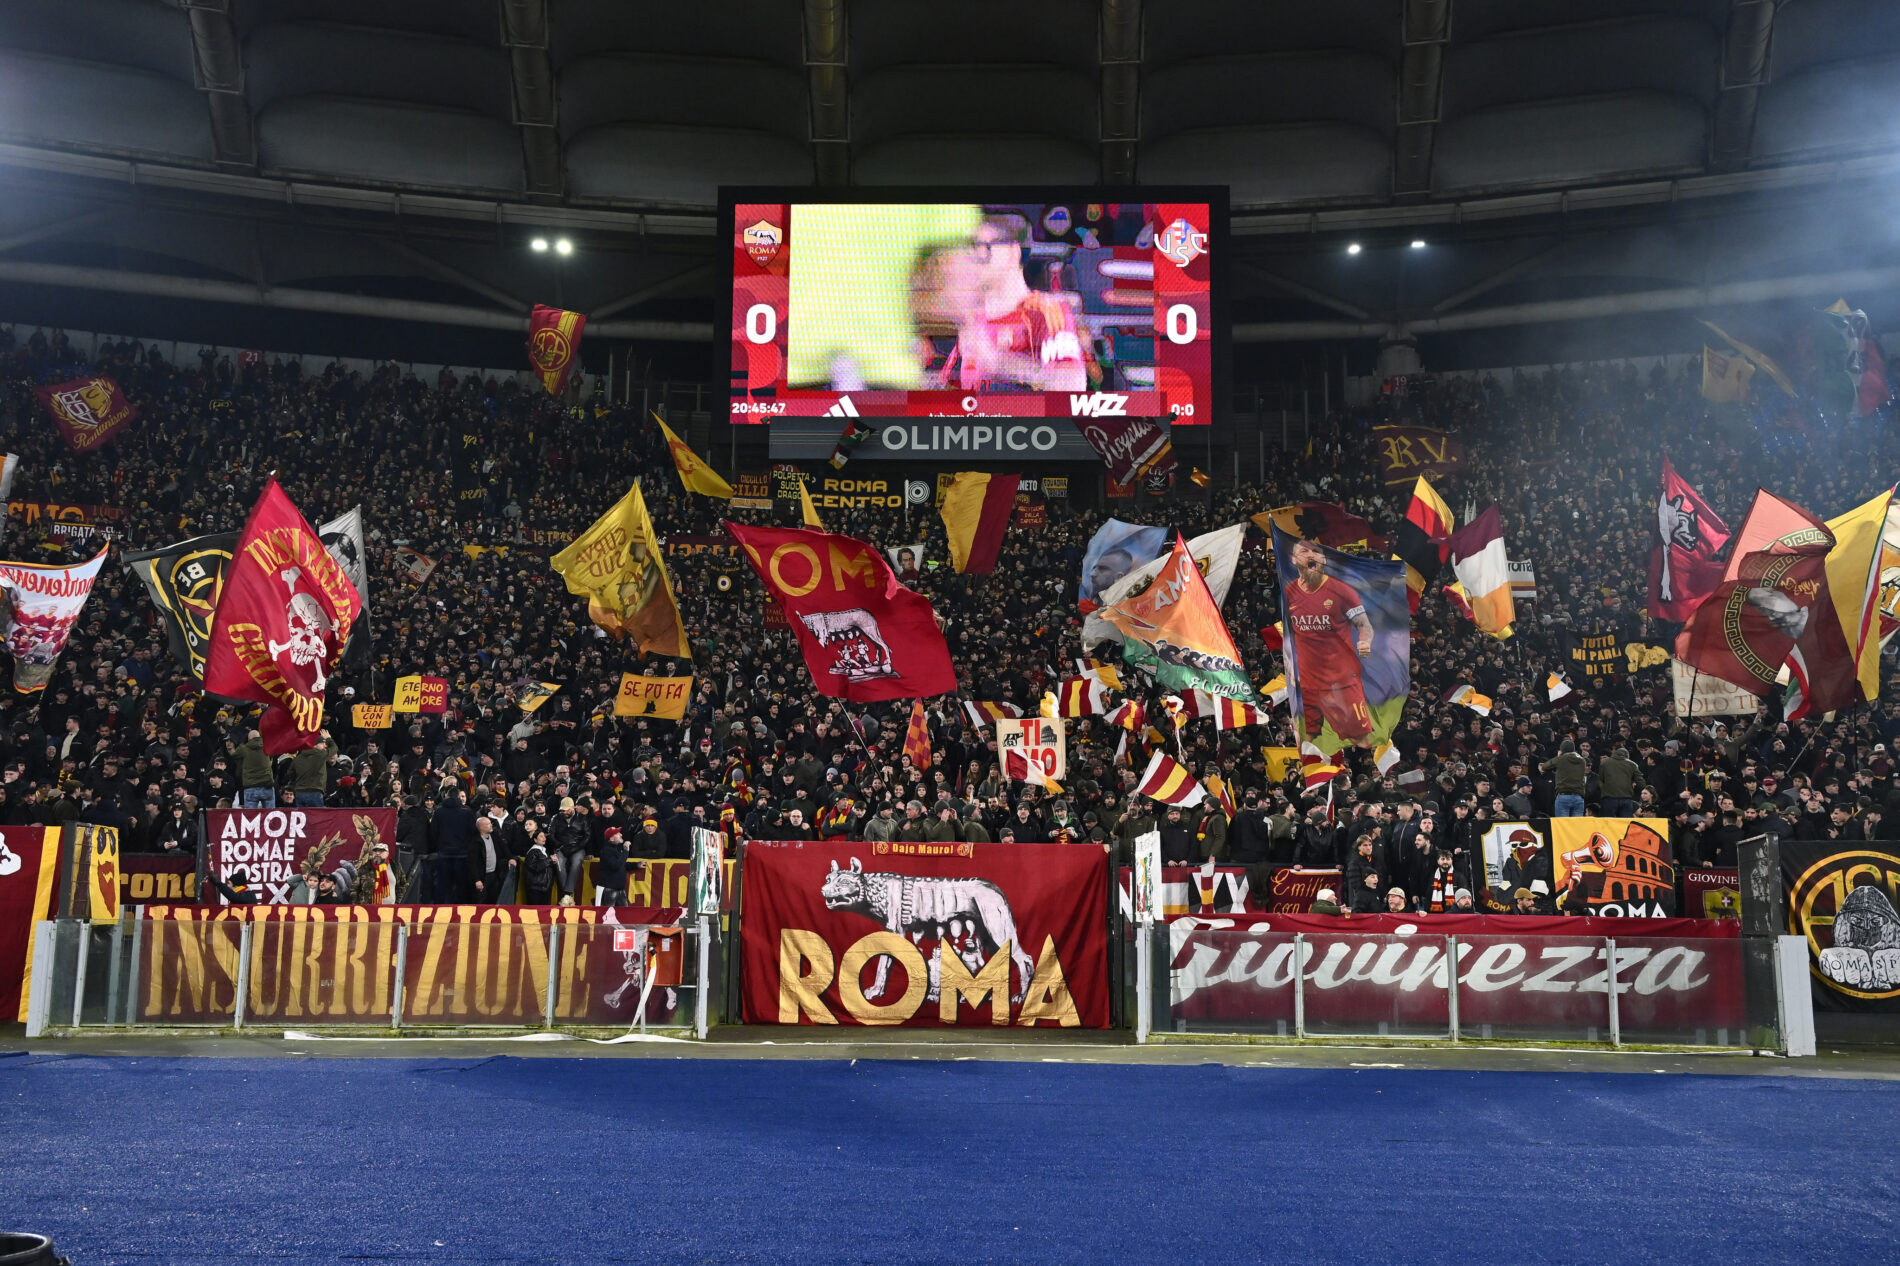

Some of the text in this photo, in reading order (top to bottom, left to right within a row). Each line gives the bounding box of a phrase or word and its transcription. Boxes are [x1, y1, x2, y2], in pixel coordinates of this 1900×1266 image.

[749, 246, 776, 254] ROMA
[746, 304, 776, 345] 0
[1166, 304, 1197, 345] 0
[732, 402, 786, 414] 20:45:47
[1070, 393, 1128, 418] WIZZ
[882, 425, 1057, 451] OLIMPICO
[824, 478, 888, 493] ROMA
[809, 494, 903, 508] CENTRO
[1582, 634, 1615, 648] TUTTO
[1572, 647, 1586, 661] MI
[1586, 663, 1615, 675] DI TE
[402, 682, 444, 692] ETERNO
[624, 681, 642, 698] SE
[402, 695, 442, 706] AMORE
[1678, 697, 1729, 713] SOLO
[361, 705, 385, 713] LELE
[362, 712, 383, 720] CON
[364, 720, 382, 728] NOI
[1020, 719, 1041, 746] TI
[221, 810, 307, 839] AMOR
[220, 838, 295, 863] ROMAE
[892, 843, 915, 854] Daje
[220, 861, 293, 884] NOSTRA
[1486, 900, 1511, 912] ROMA
[145, 904, 596, 1019] INSURREZIONE
[778, 928, 1081, 1027] ROMA
